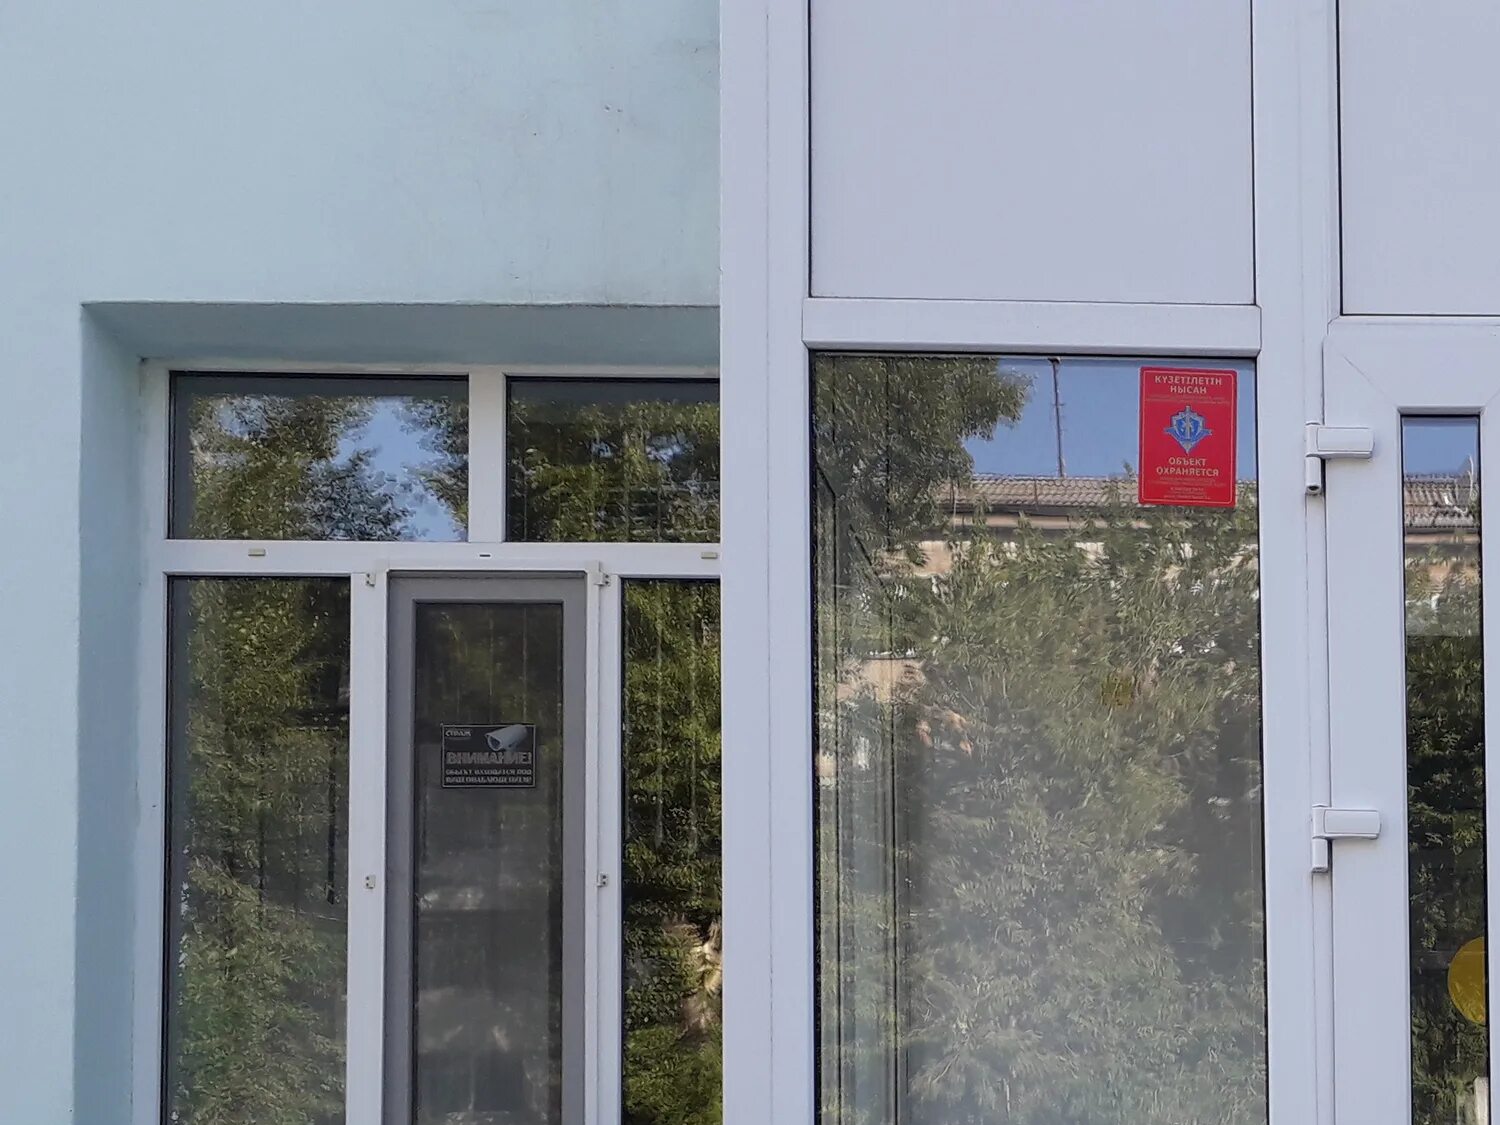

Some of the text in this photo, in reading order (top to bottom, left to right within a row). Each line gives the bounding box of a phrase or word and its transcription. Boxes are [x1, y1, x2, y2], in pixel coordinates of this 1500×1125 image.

[1170, 385, 1207, 394] НЫСАН
[1168, 457, 1208, 466] ОБЪЕКТ
[1156, 466, 1219, 477] ОХРАНЯЕТСЯ
